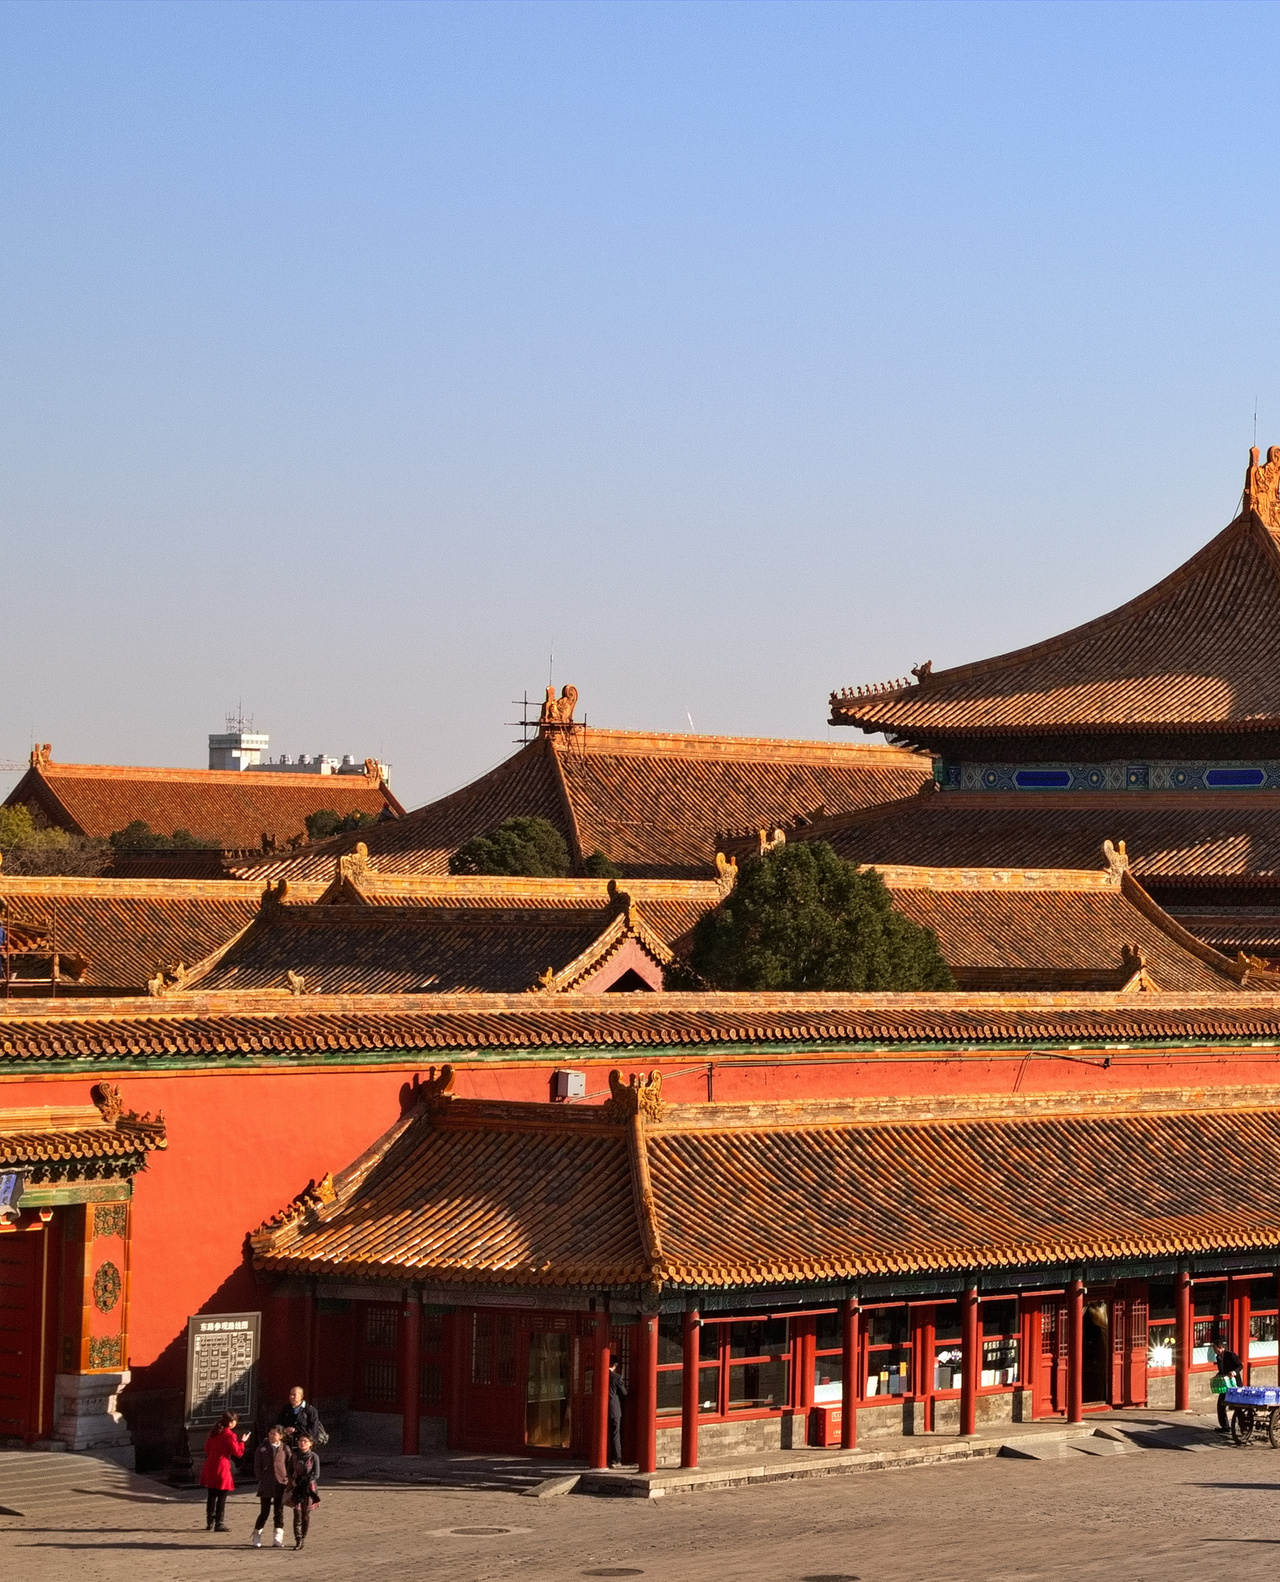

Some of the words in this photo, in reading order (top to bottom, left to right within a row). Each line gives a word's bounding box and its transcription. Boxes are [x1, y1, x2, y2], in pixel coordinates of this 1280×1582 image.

[200, 1321, 249, 1332] 东路参观路线图
